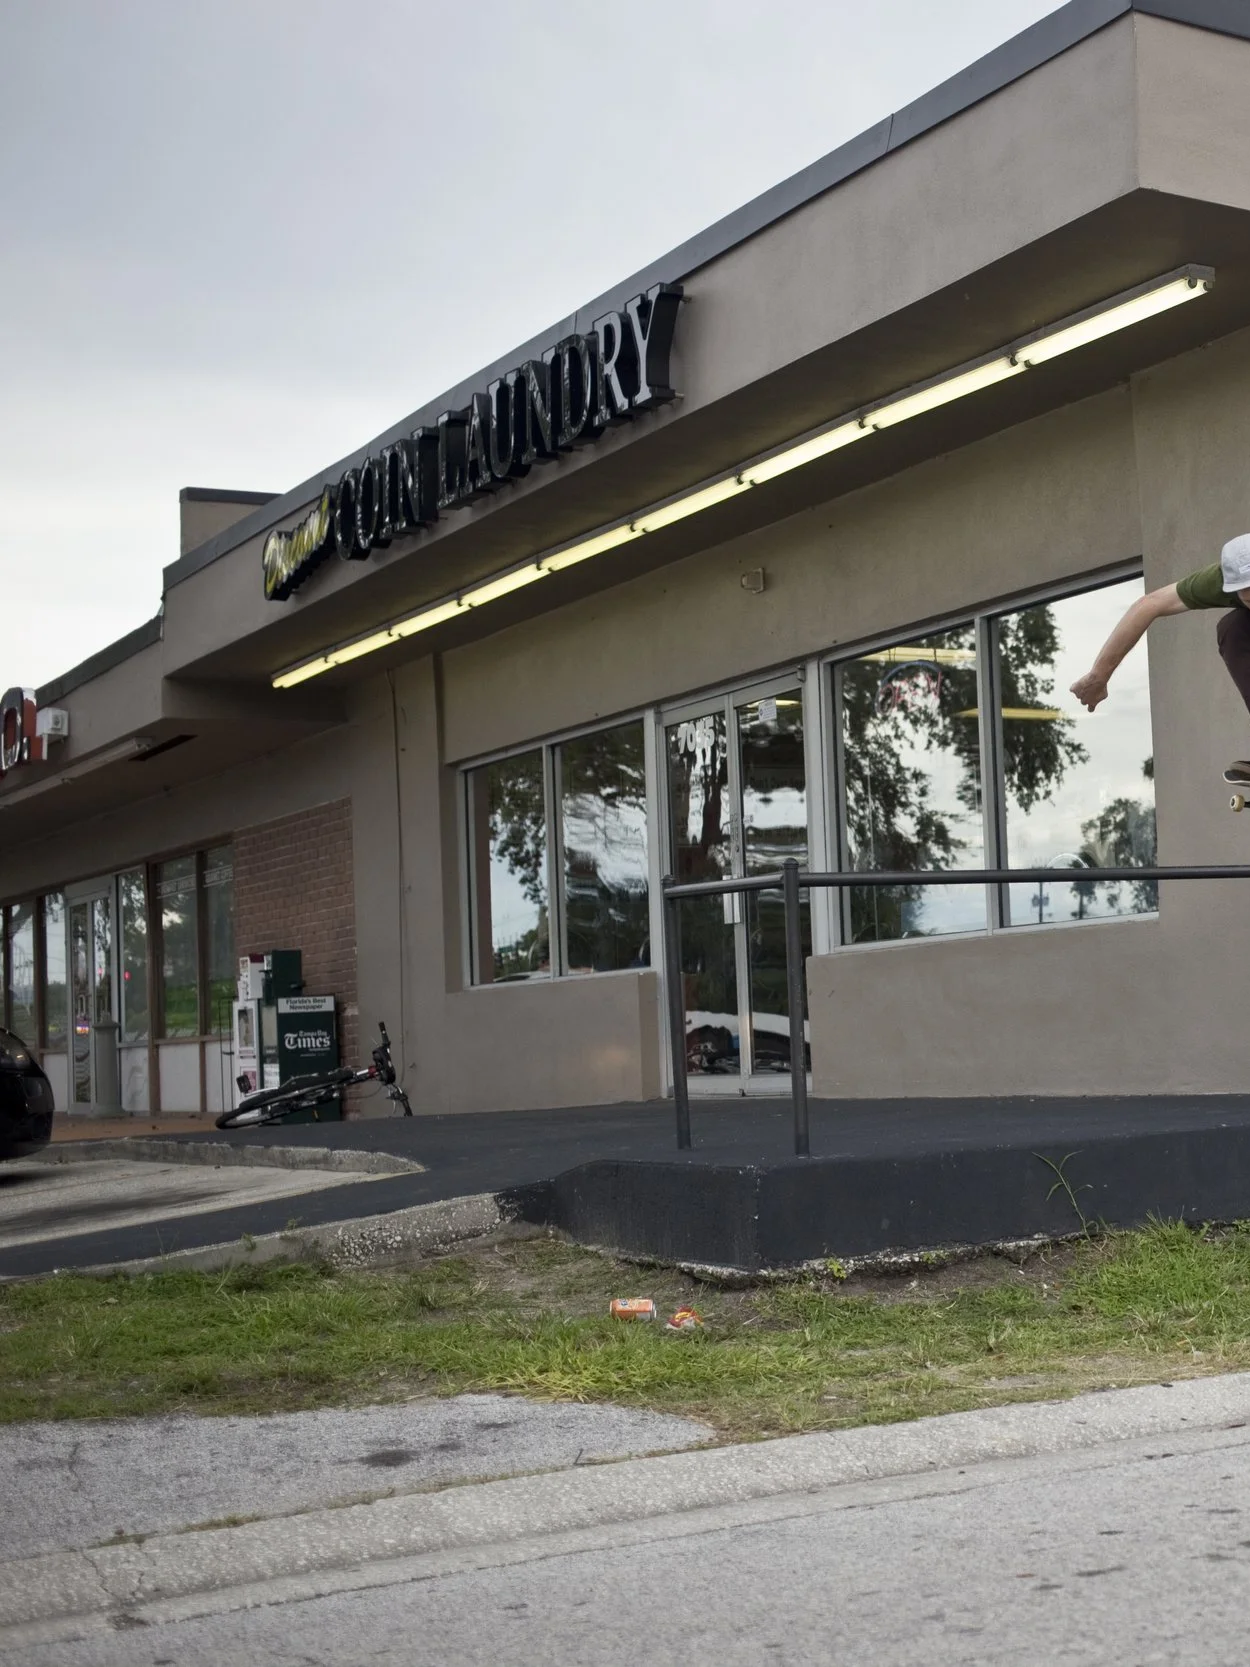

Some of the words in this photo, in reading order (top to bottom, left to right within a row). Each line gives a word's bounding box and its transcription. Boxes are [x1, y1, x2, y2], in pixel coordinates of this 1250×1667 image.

[334, 426, 439, 561] COIN
[437, 282, 684, 510] LAUNDRY
[284, 1032, 332, 1050] Times
